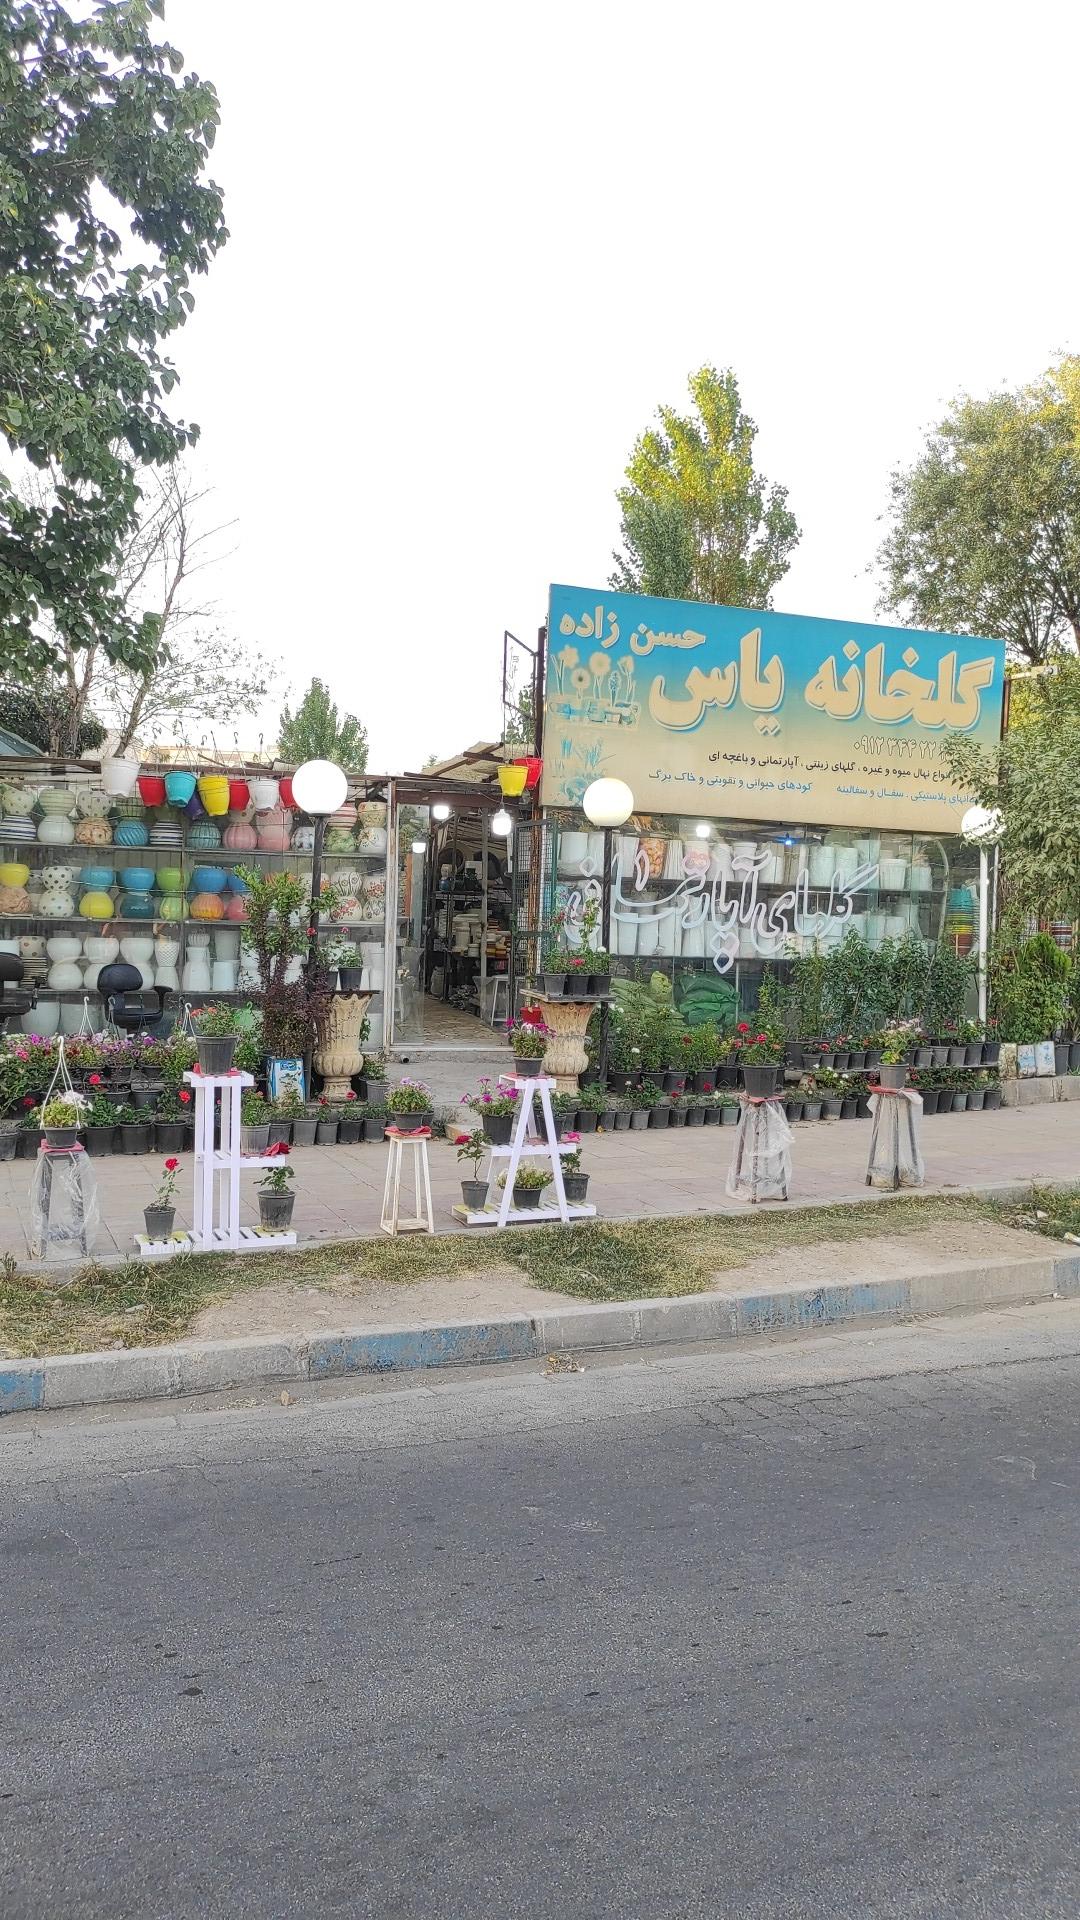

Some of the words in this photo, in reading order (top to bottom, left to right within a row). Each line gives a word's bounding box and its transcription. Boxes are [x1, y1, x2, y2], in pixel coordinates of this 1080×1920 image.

[559, 605, 620, 649] زاده
[630, 623, 706, 656] حسن
[649, 627, 785, 737] یاس
[804, 640, 996, 732] گلخانه
[708, 750, 720, 761] ای
[722, 752, 749, 765] باغچه
[750, 756, 756, 766] و
[758, 755, 799, 770] آپارتمانی
[805, 760, 829, 771] زینتی
[831, 761, 856, 773] گلهای
[648, 768, 672, 783] برگ
[863, 765, 882, 775] غیره
[885, 767, 890, 777] و
[892, 766, 911, 778] میوه
[913, 768, 930, 780] نهال
[674, 772, 696, 782] خاک
[699, 776, 704, 785] و
[706, 775, 737, 787] تقویتی
[738, 779, 744, 788] و
[746, 777, 775, 791] حیوانی
[777, 780, 813, 794] کودهای
[870, 788, 875, 798] و
[750, 861, 880, 956] گلهای
